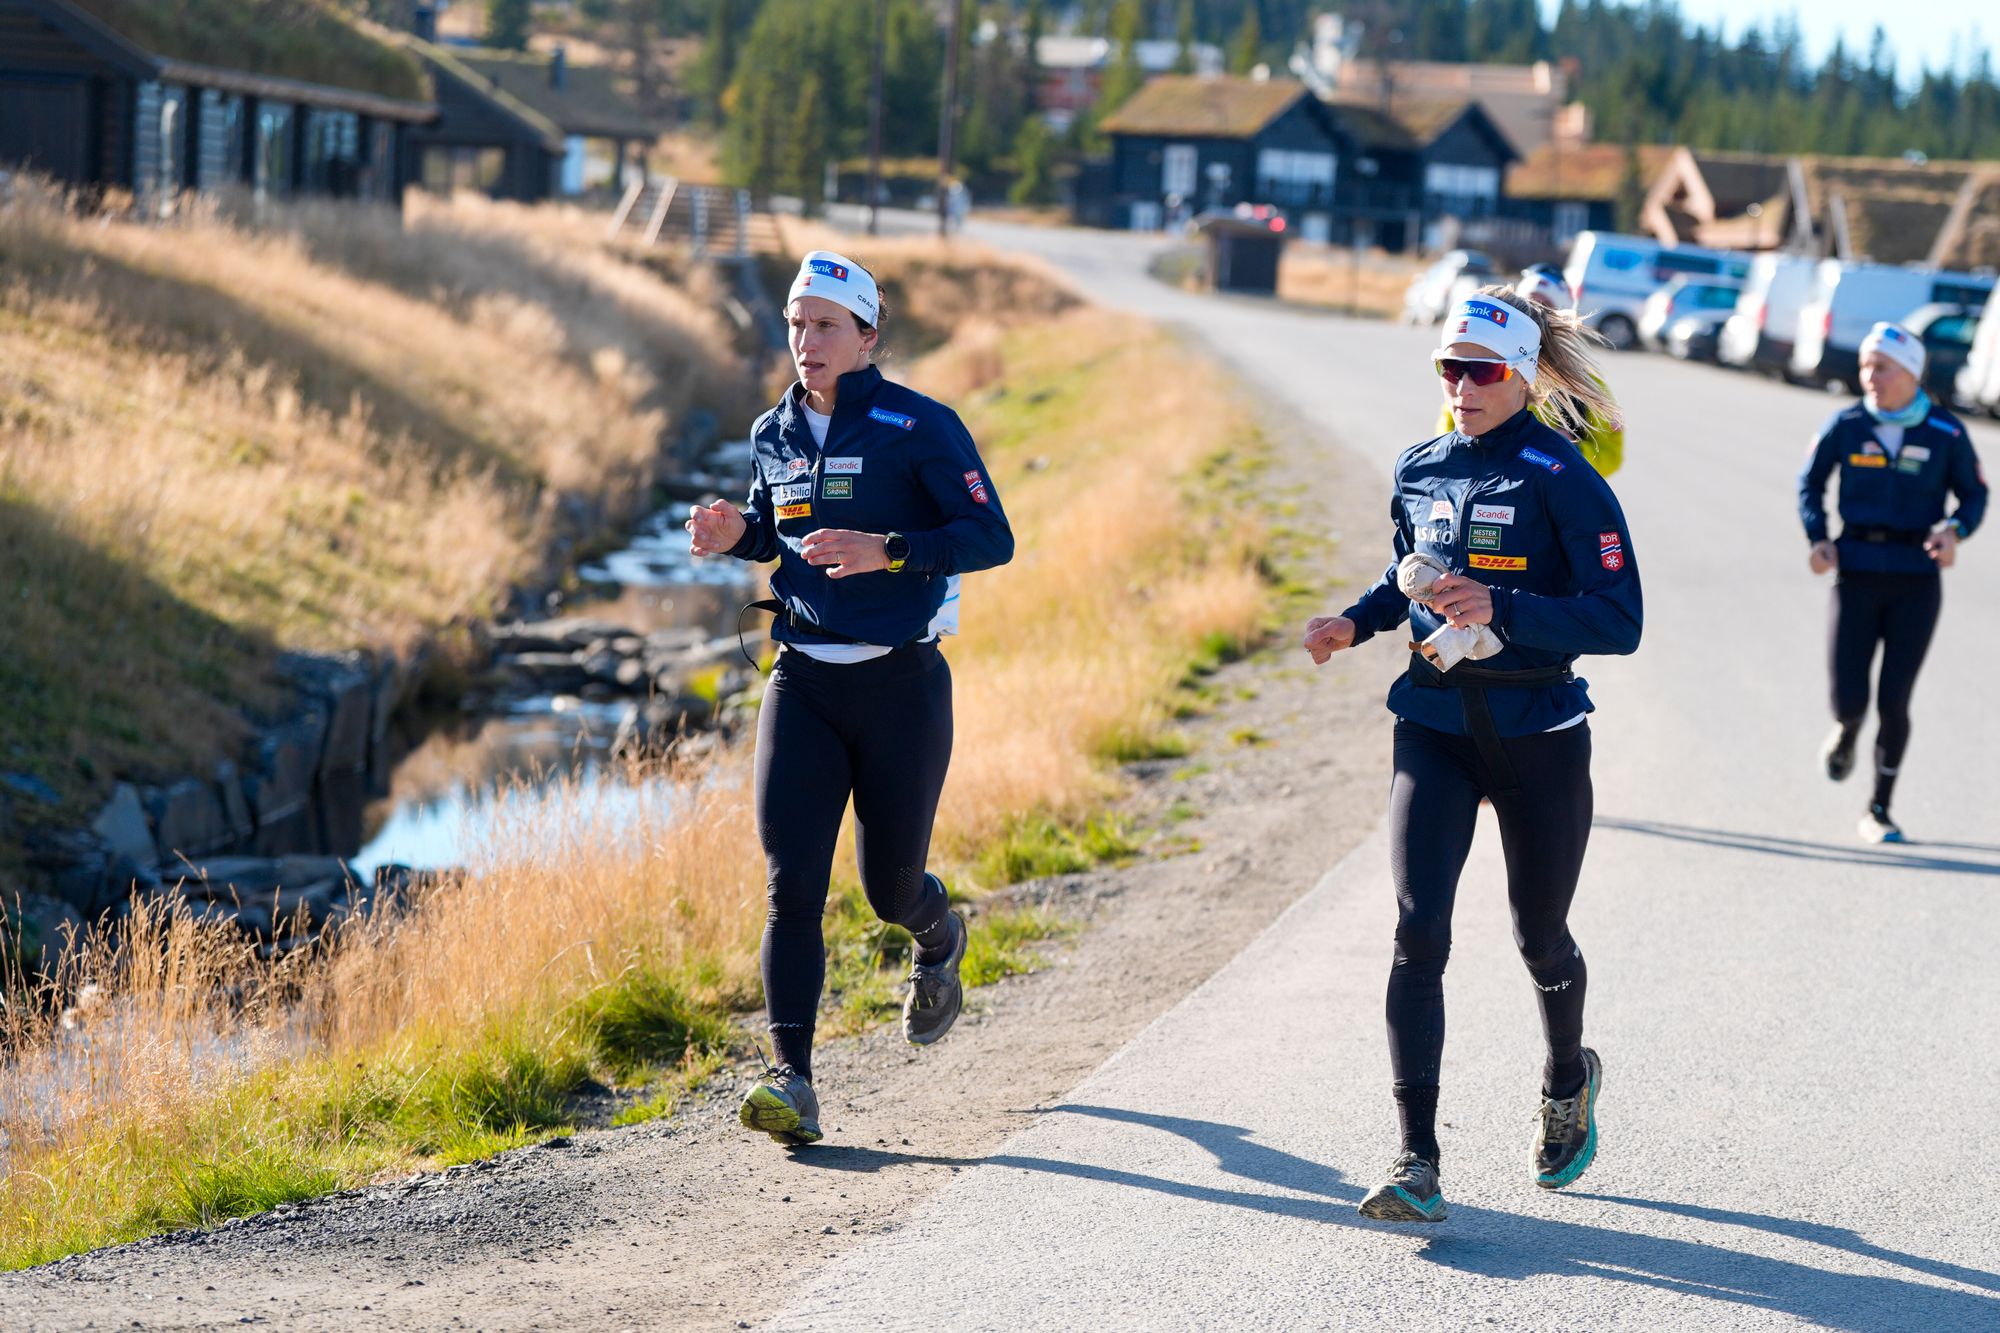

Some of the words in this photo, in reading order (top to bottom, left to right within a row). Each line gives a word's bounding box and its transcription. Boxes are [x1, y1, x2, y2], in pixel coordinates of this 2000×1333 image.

[829, 461, 859, 470] Scandic
[965, 471, 979, 481] NOR
[1475, 508, 1511, 520] Scandic
[1472, 529, 1497, 537] MESTER
[1472, 537, 1496, 546] GRØNN
[1600, 534, 1618, 543] NOR
[1476, 556, 1519, 569] DHL
